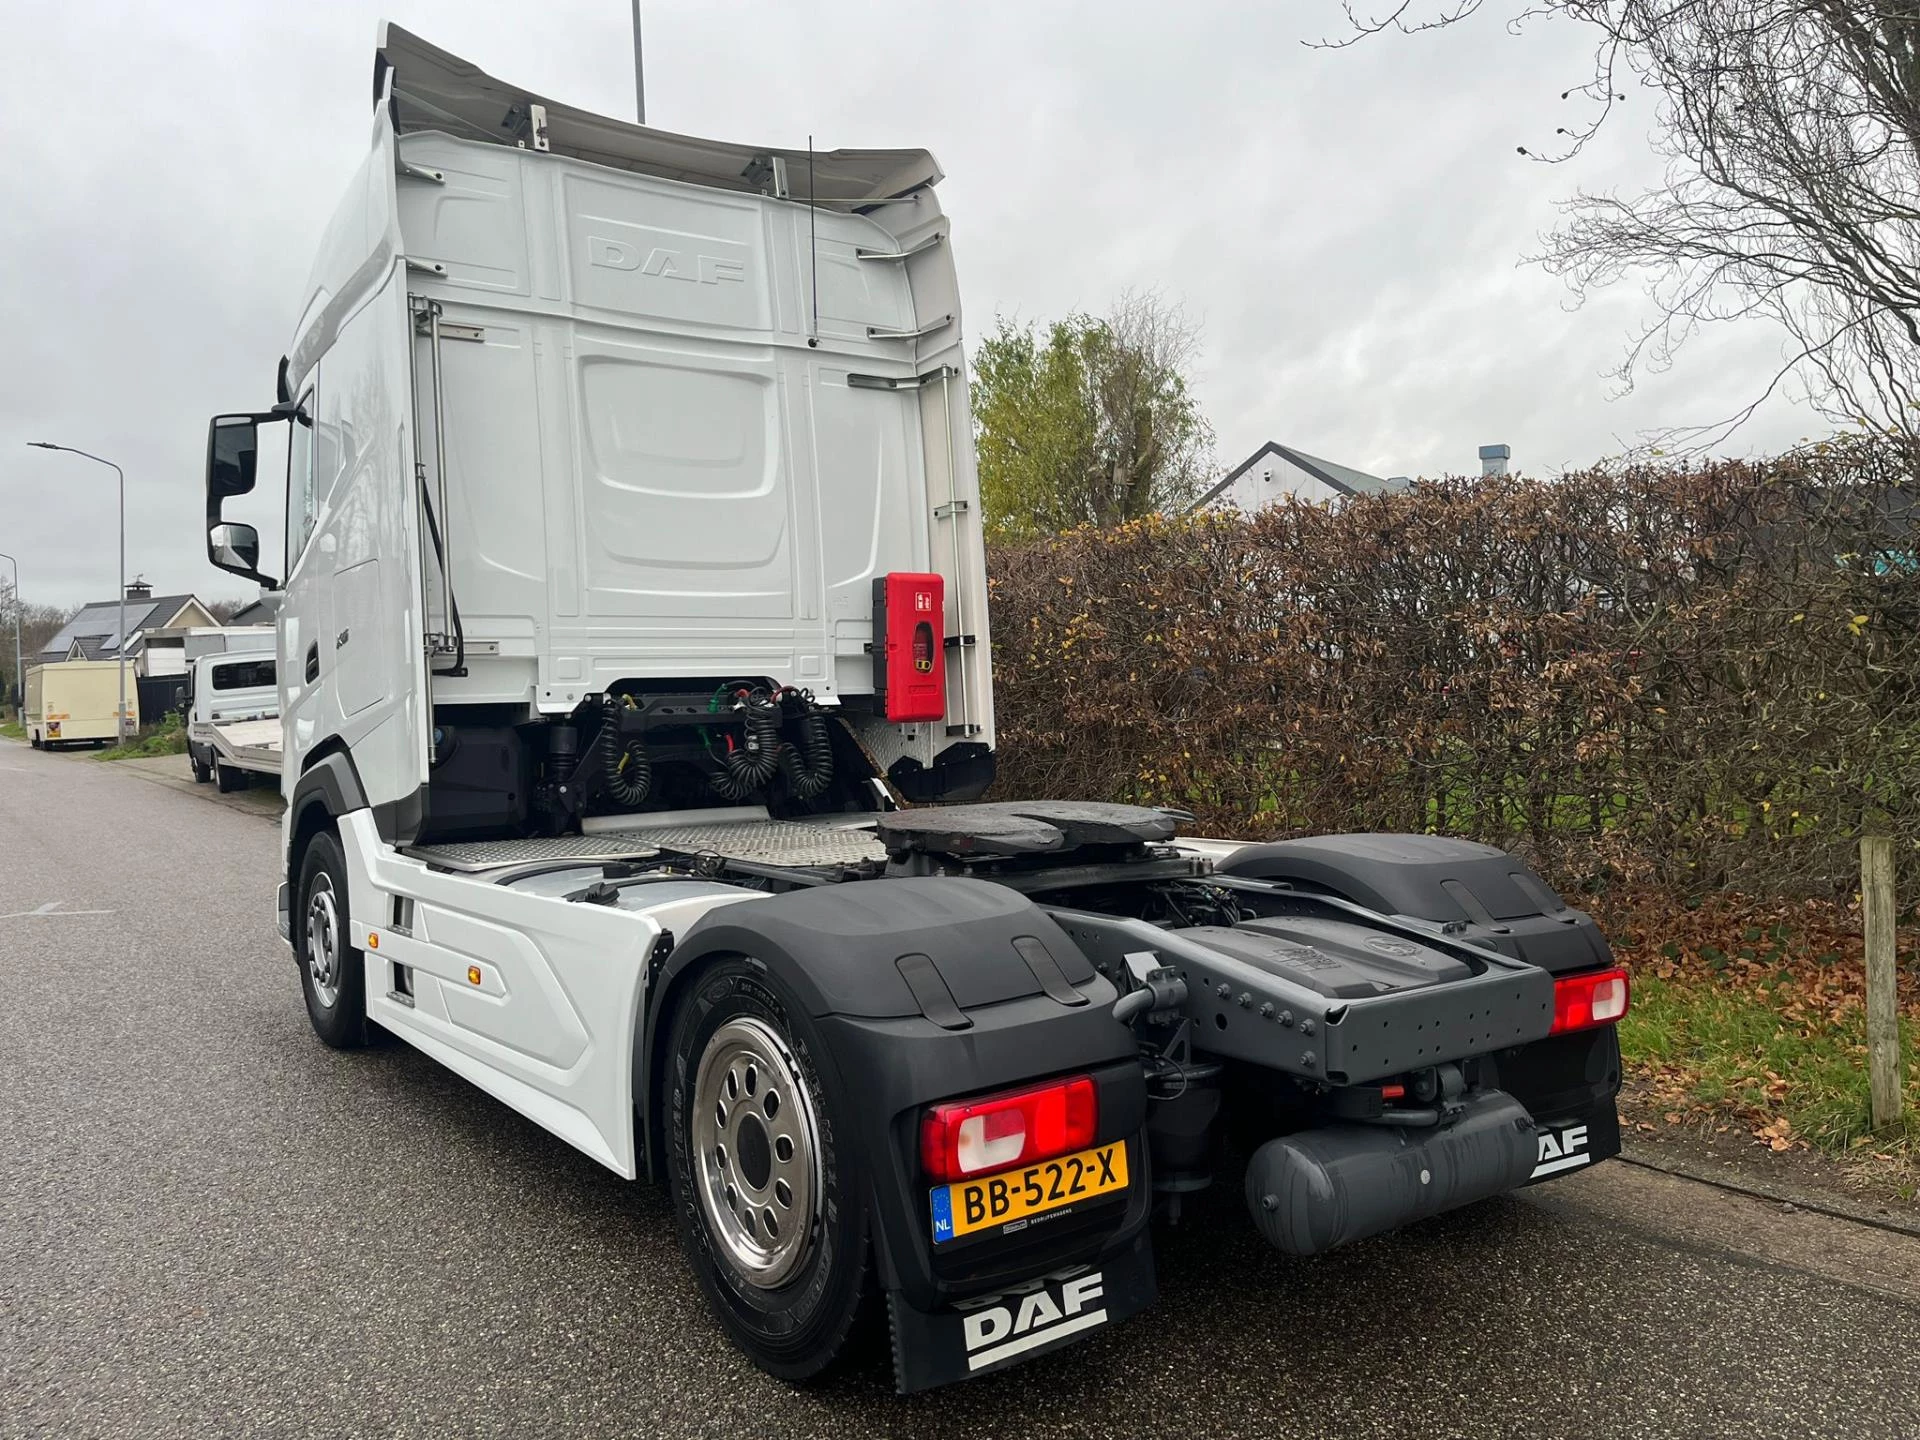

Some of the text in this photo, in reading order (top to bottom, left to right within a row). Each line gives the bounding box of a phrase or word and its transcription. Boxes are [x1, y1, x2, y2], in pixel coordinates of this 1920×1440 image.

[587, 236, 744, 285] DAF
[1537, 1125, 1588, 1162] AF
[964, 1149, 1116, 1224] BB-522-X
[935, 1218, 951, 1233] NL
[963, 1271, 1104, 1352] DAF
